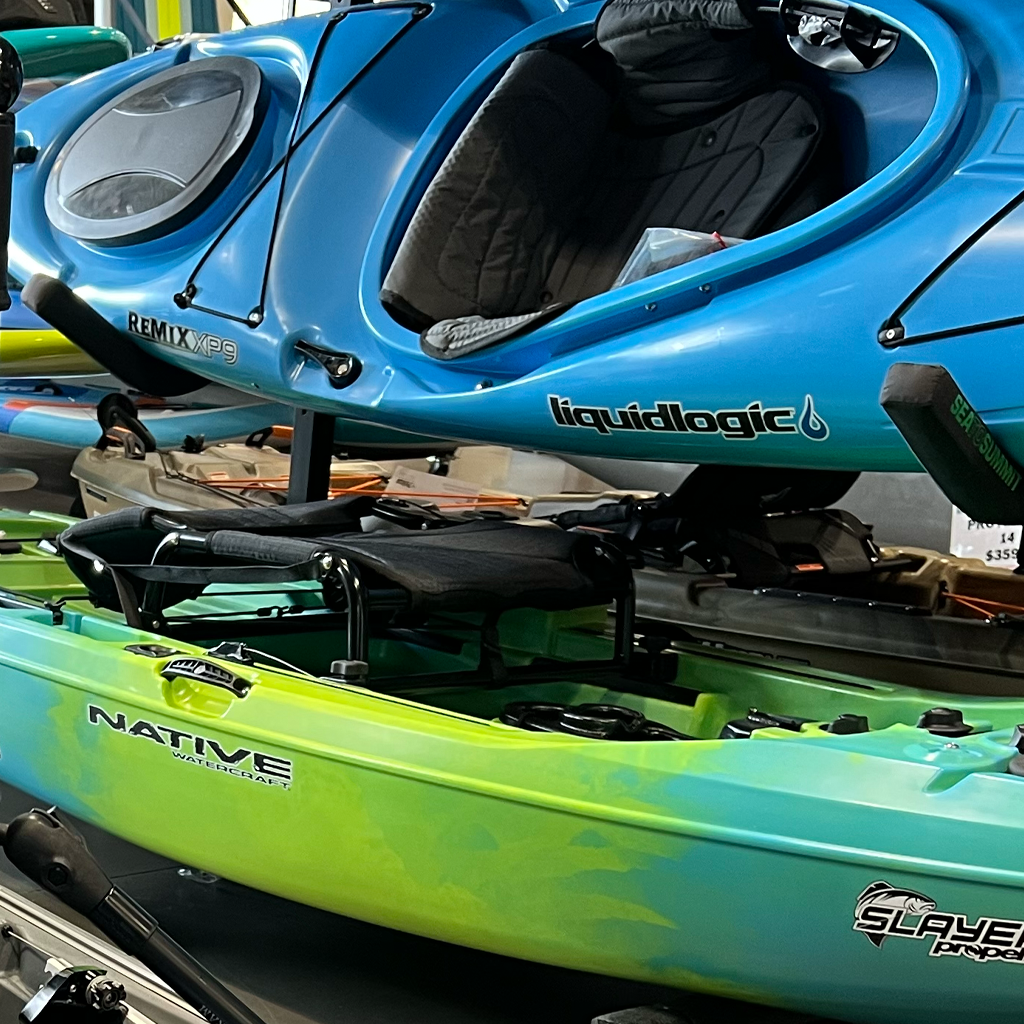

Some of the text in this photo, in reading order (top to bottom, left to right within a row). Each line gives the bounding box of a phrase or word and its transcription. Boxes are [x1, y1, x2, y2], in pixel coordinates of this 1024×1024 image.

[192, 331, 238, 365] XP9
[547, 394, 799, 440] liquidlogic
[950, 394, 974, 432] SEA
[978, 432, 1022, 492] SUMMIT
[1000, 532, 1015, 544] 14
[88, 704, 292, 780] NATIVE
[172, 750, 291, 789] WATERCRAFT
[854, 904, 1024, 948] SLAYE
